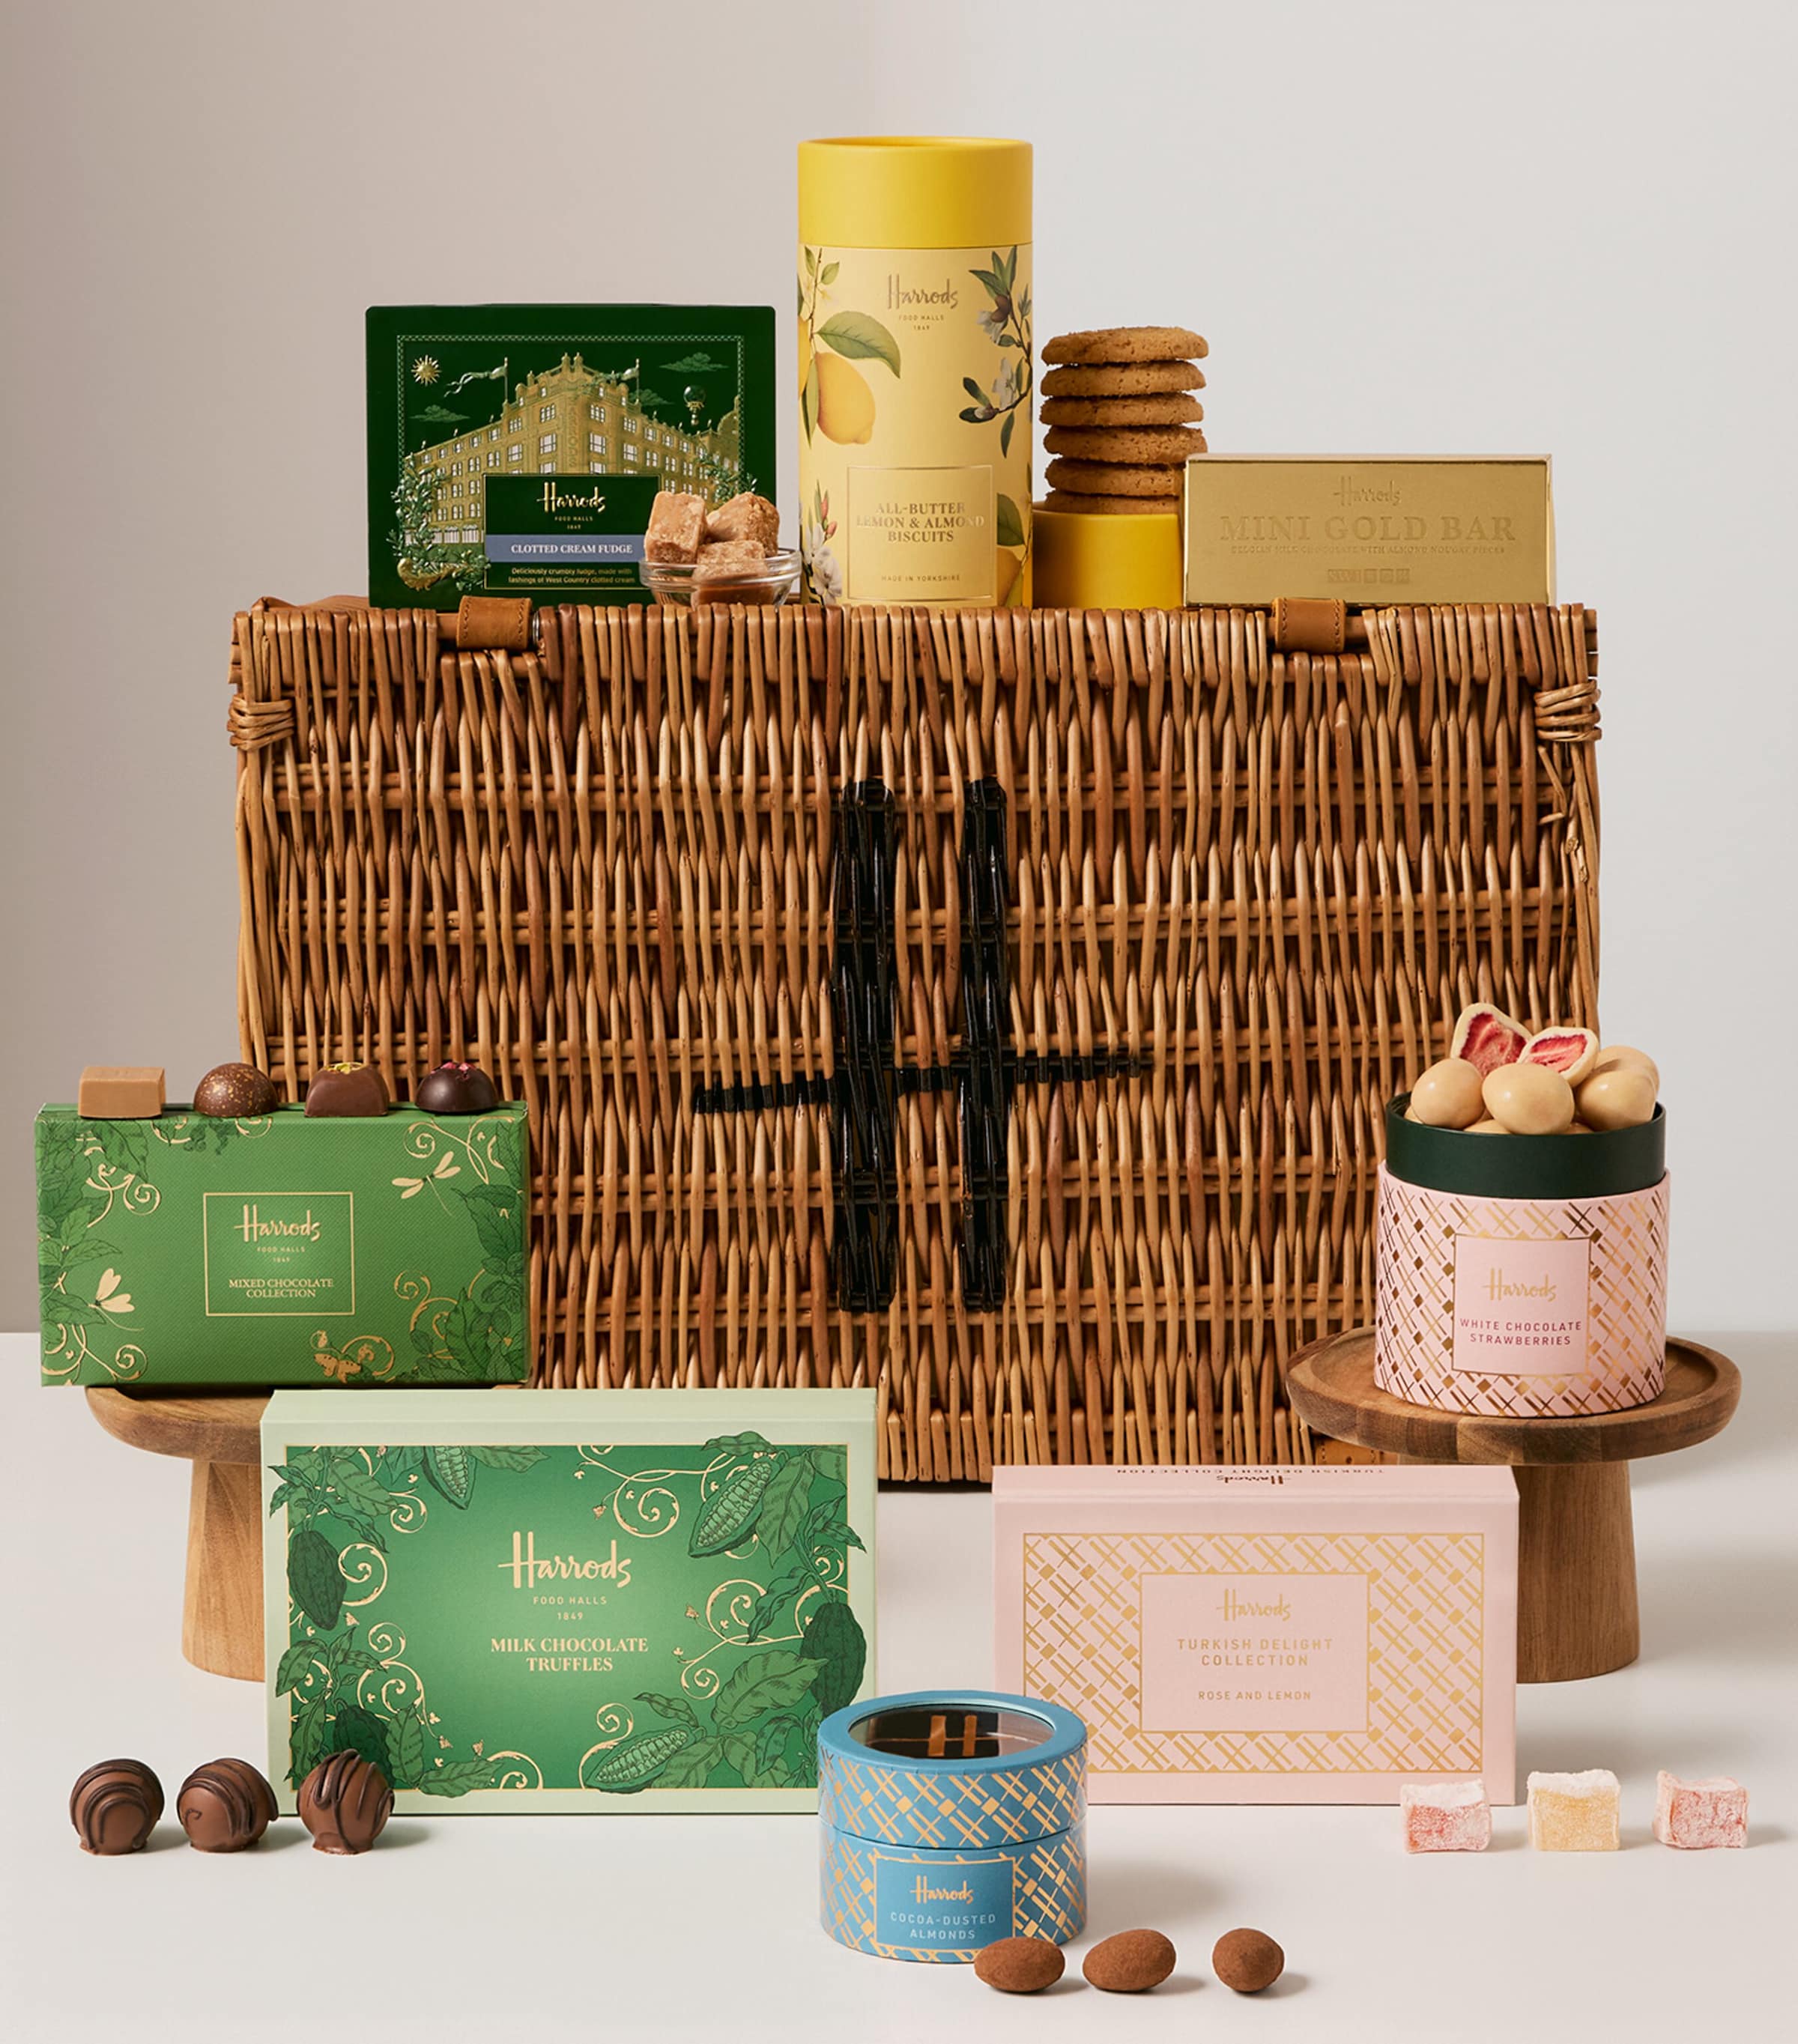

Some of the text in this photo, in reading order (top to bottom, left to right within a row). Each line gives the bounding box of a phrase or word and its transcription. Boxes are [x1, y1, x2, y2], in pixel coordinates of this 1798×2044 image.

[886, 273, 958, 309] Harrods
[536, 482, 605, 512] Harrods
[1333, 476, 1402, 507] Harrods
[876, 503, 965, 515] ALL-BUTTER
[856, 515, 984, 529] LEMON & ALMOND
[1220, 515, 1516, 541] MINI GOLD BAR
[888, 530, 954, 542] BISCUITS
[511, 544, 633, 554] CLOTTED CREAM FUDGE
[512, 568, 548, 576] Deliciously
[548, 568, 575, 576] crumbly
[576, 568, 597, 576] fudge,
[688, 776, 1152, 1312] H
[234, 1204, 321, 1243] Harrods
[228, 1278, 334, 1288] MIXED CHOCOLATE
[1482, 1267, 1558, 1302] Harrods
[246, 1288, 316, 1298] COLLECTION
[1459, 1317, 1582, 1332] WHITE CHOCOLATE
[1470, 1332, 1571, 1346] STRAWBERRIES
[1216, 1475, 1292, 1485] Harrods
[497, 1531, 632, 1589] Harrods
[533, 1596, 608, 1605] FOOD HALLS
[1216, 1588, 1292, 1622] Harrods
[557, 1612, 584, 1621] 1849
[491, 1637, 649, 1653] MILK CHOCOLATE
[1177, 1638, 1333, 1650] TURKISH DELIGHT
[526, 1657, 614, 1672] TRUFFLES
[1201, 1654, 1309, 1667] COLLECTION
[1199, 1690, 1312, 1700] ROSE AND LEMON
[909, 1875, 974, 1905] Harrods
[890, 1911, 996, 1926] COCOA-DUSTED
[909, 1929, 976, 1940] ALMONDS
